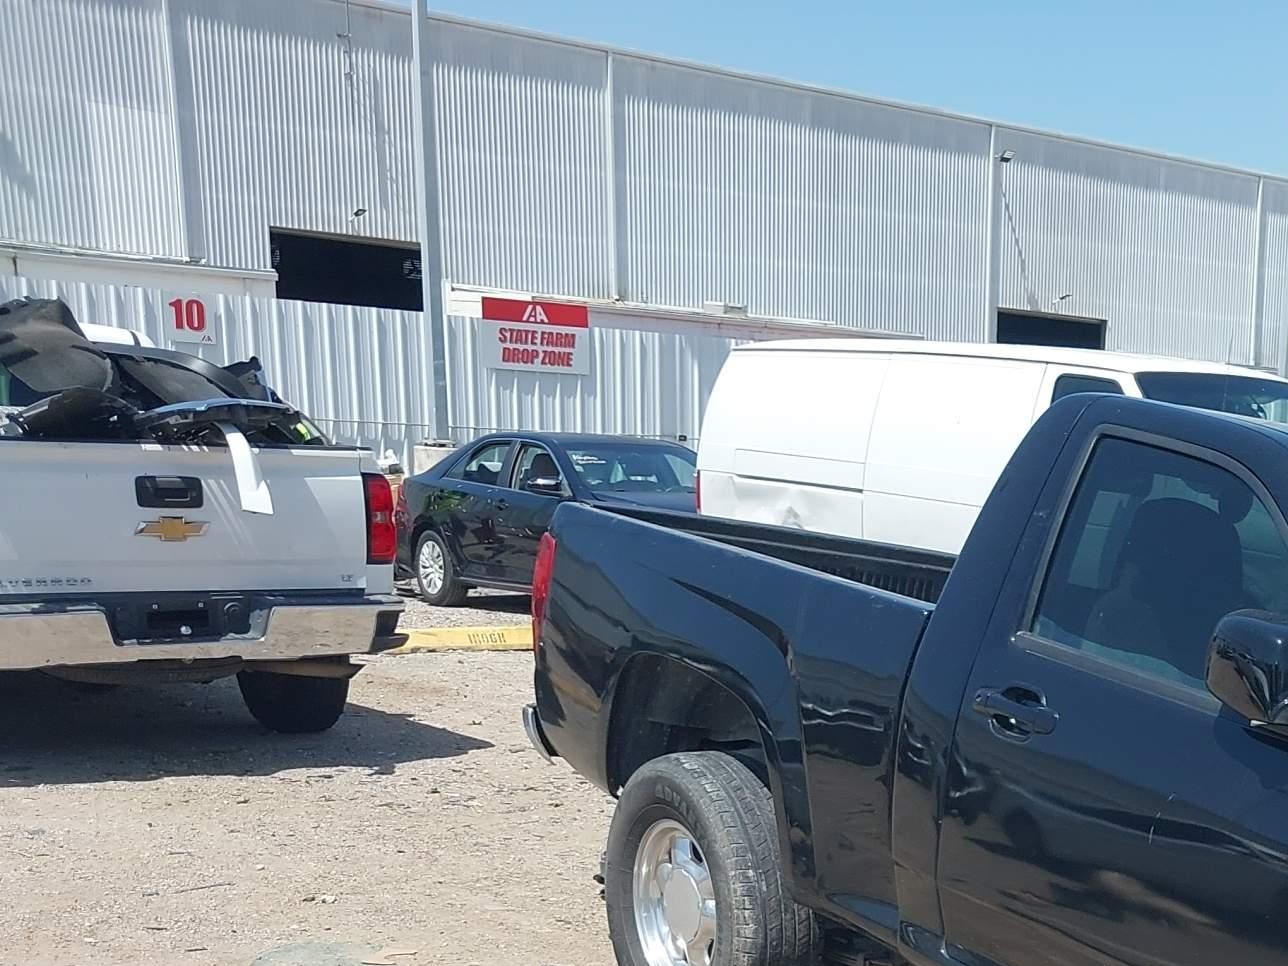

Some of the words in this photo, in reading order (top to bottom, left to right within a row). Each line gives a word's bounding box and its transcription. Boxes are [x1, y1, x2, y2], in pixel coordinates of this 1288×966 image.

[168, 299, 205, 331] 10
[498, 327, 538, 346] STATE
[540, 330, 576, 349] FARM
[502, 346, 539, 365] DROP
[541, 350, 574, 367] ZONE
